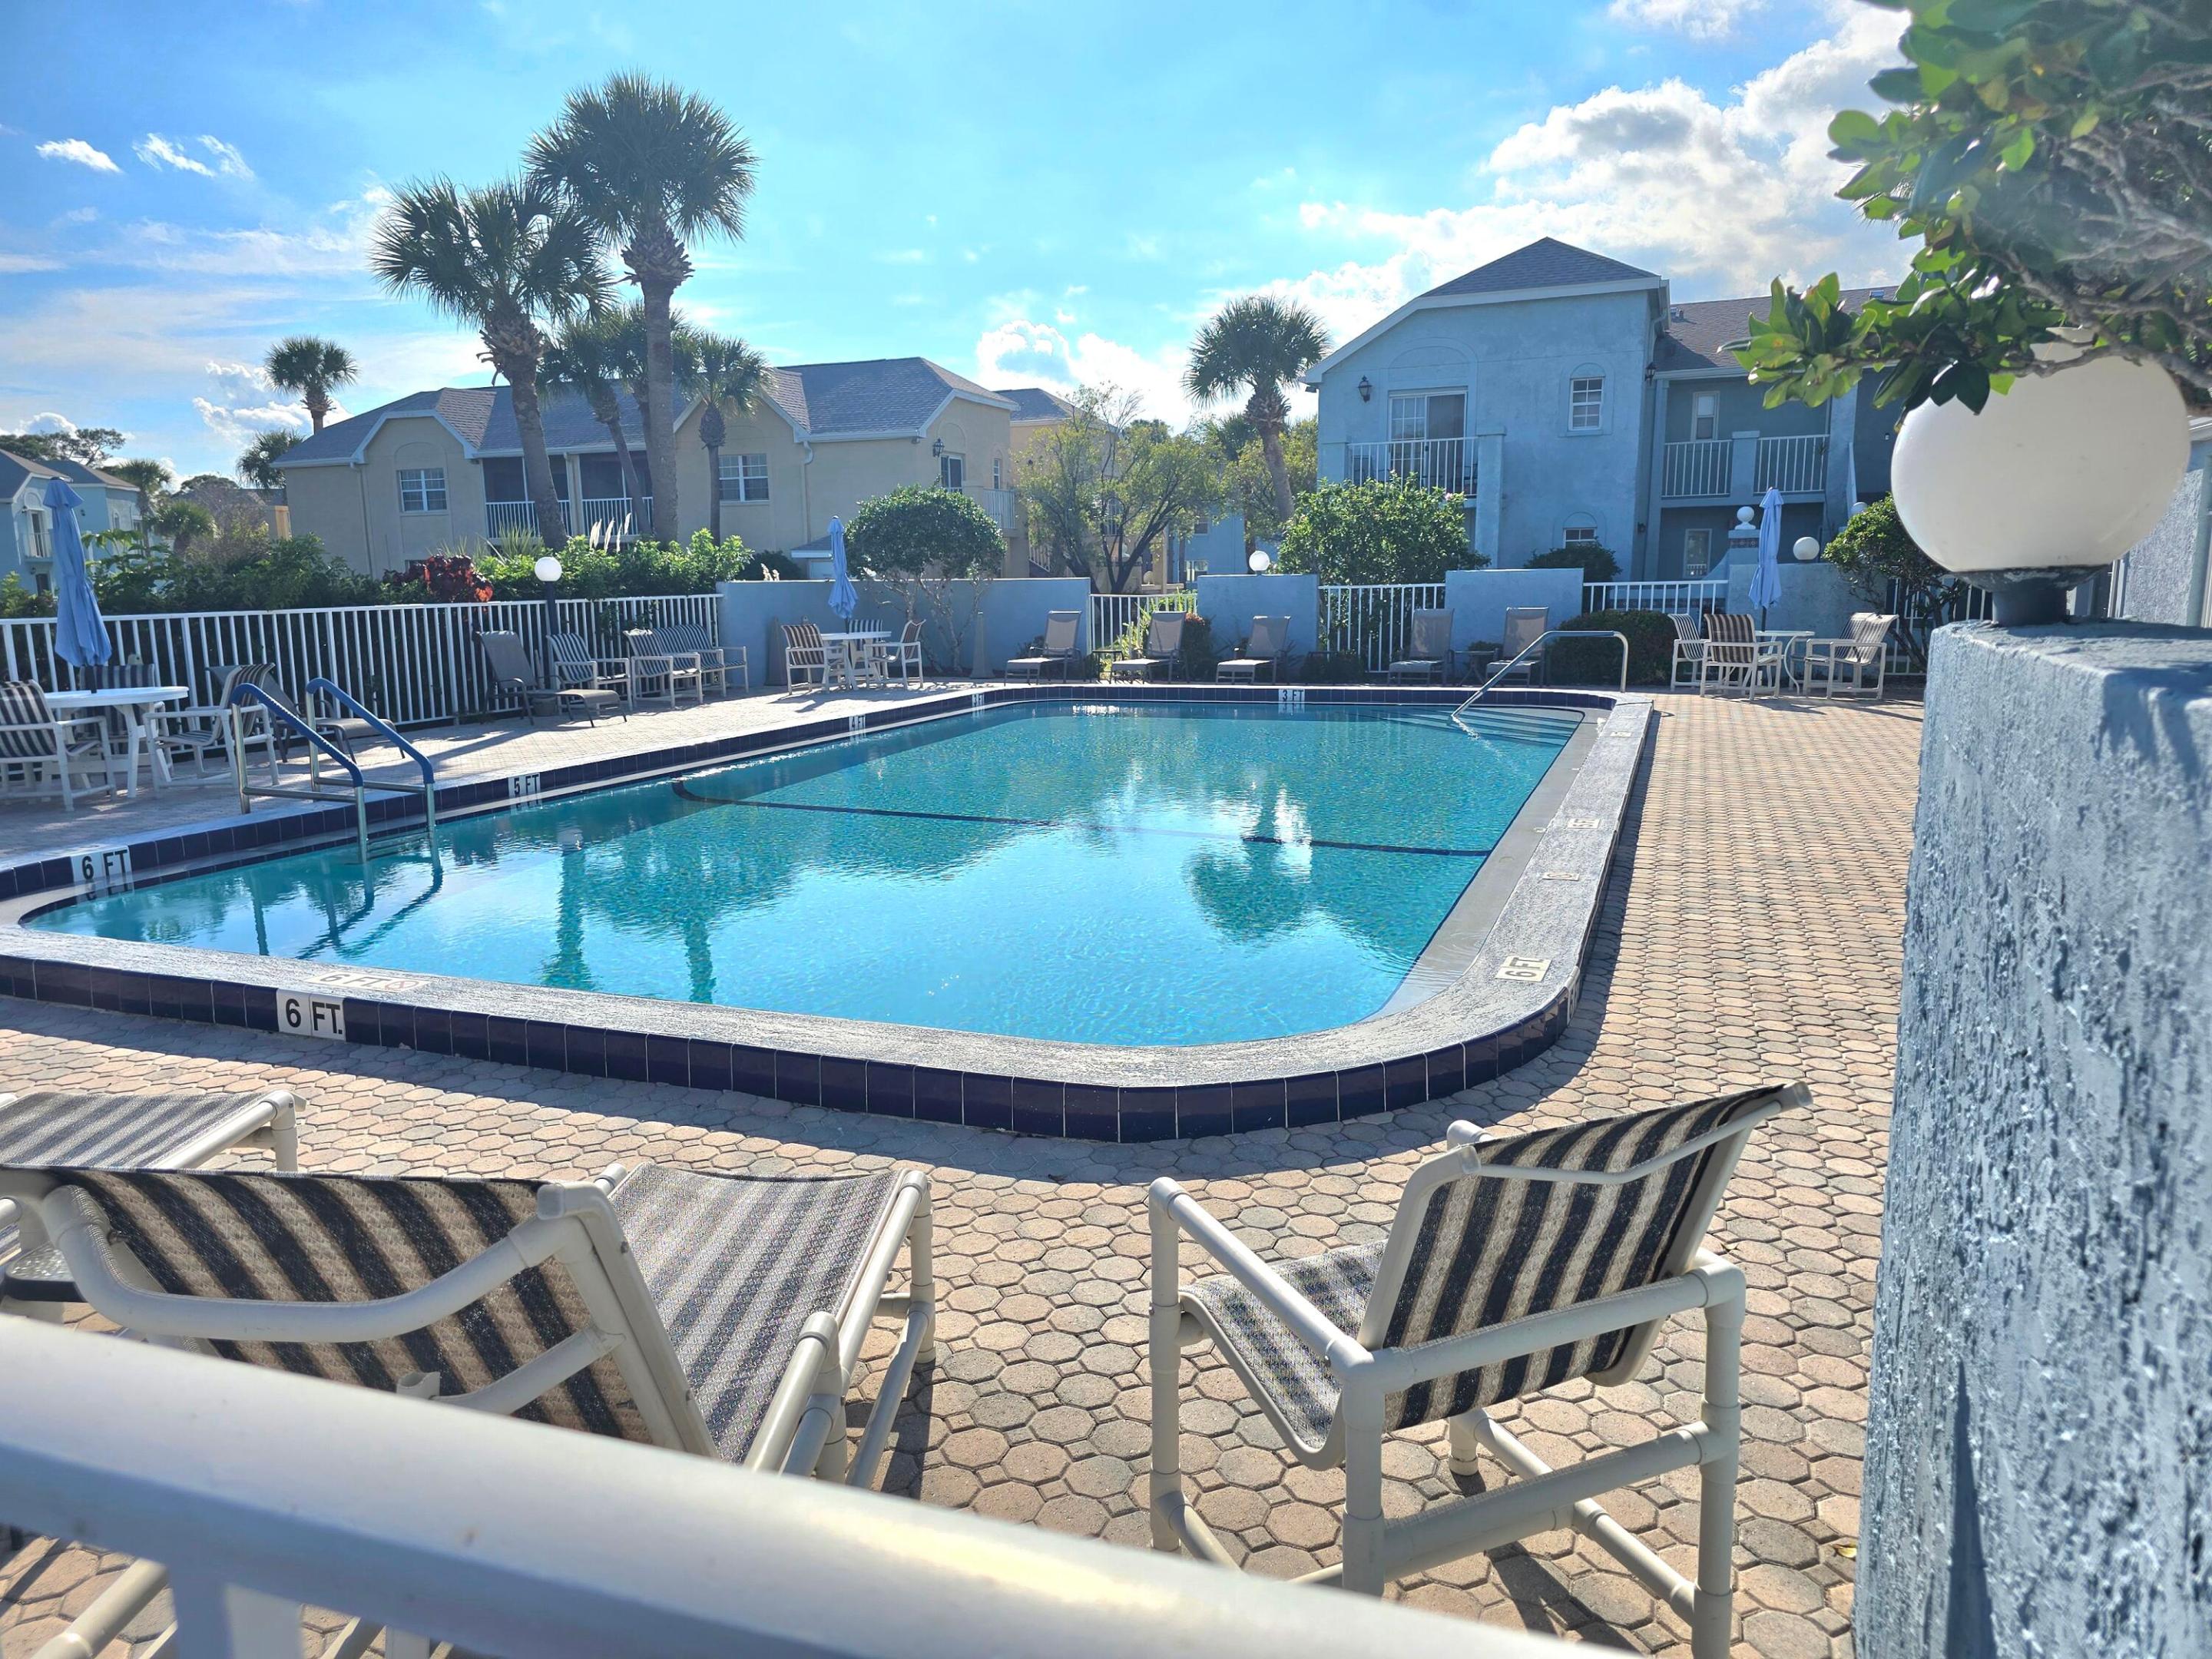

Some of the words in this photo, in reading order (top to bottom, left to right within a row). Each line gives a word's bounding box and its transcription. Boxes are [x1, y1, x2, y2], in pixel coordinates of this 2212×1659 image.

[1283, 690, 1287, 700] 3
[1292, 690, 1303, 701] FT
[514, 777, 521, 795] 5
[525, 773, 539, 795] FT
[81, 856, 94, 880] 6
[103, 849, 128, 879] FT
[320, 974, 350, 982] 6
[286, 998, 302, 1028] 6
[312, 1001, 343, 1035] FT.
